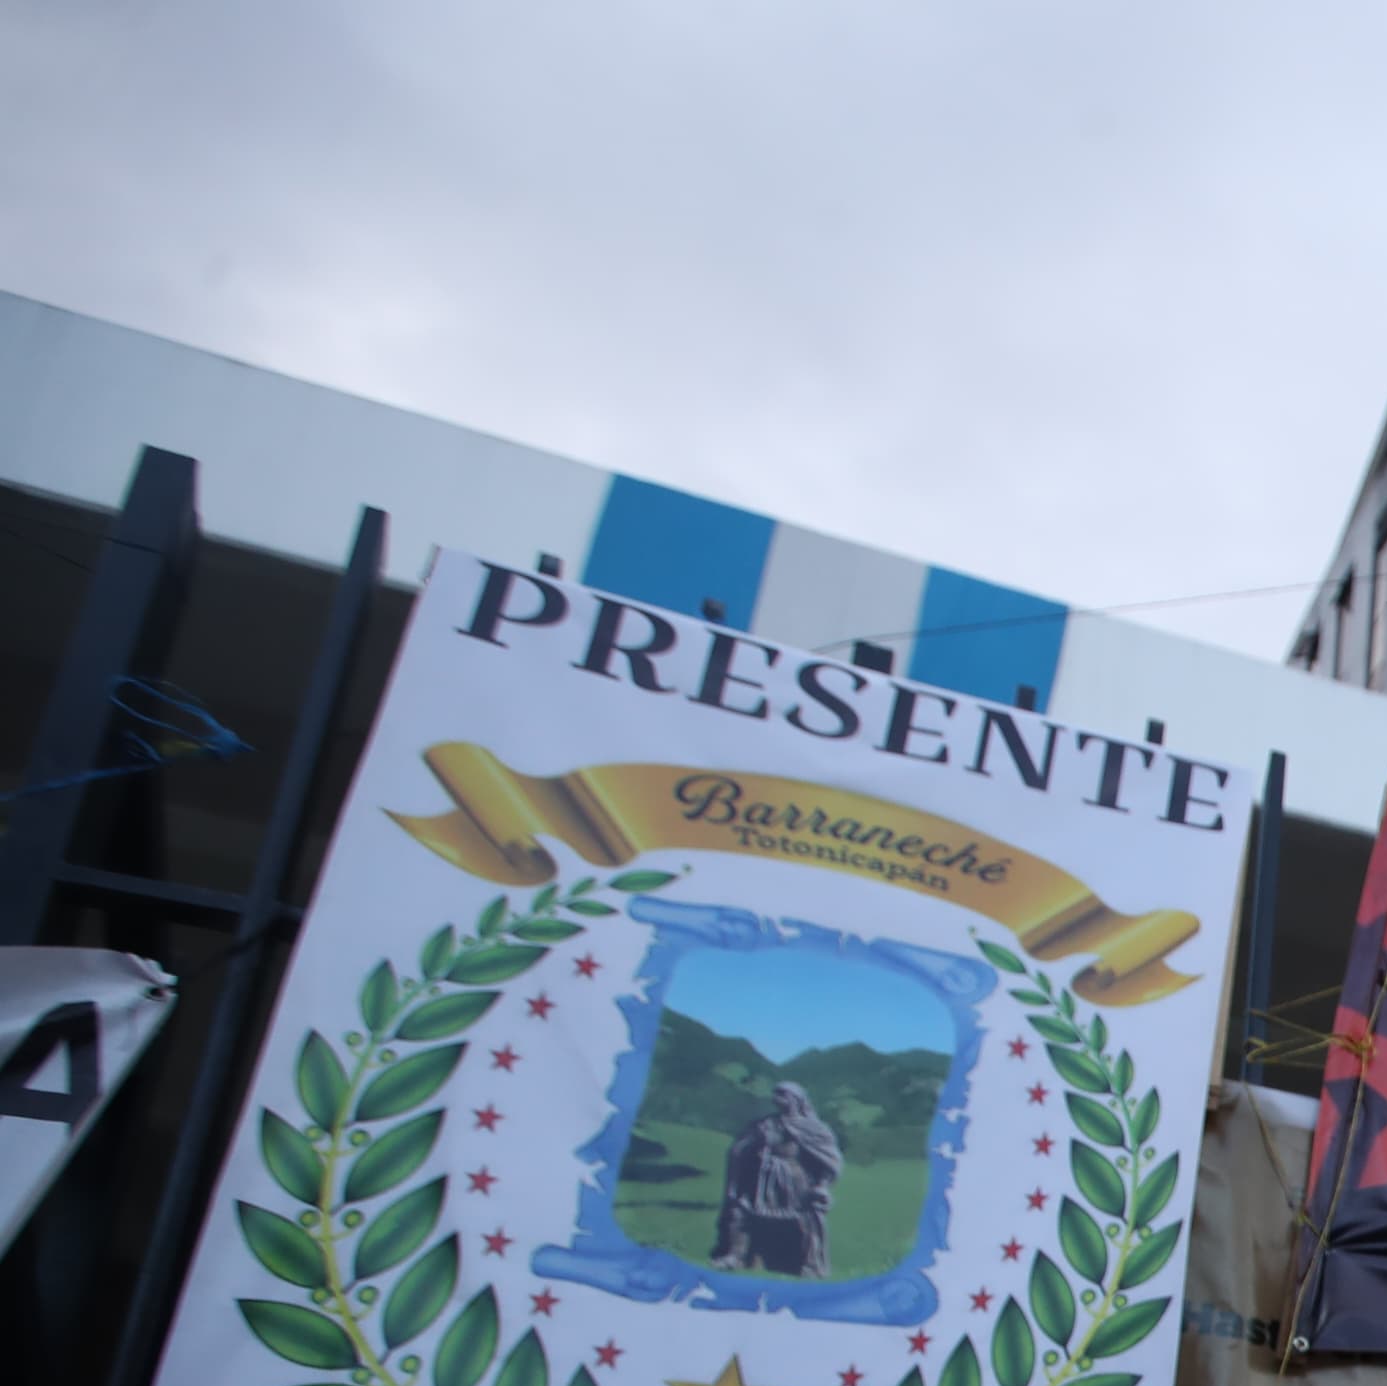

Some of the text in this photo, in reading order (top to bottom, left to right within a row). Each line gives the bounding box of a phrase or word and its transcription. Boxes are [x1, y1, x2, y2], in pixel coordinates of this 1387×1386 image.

[453, 556, 1234, 833] PRESENTE
[673, 773, 1012, 884] Barraneché
[731, 824, 951, 893] Totonicapán
